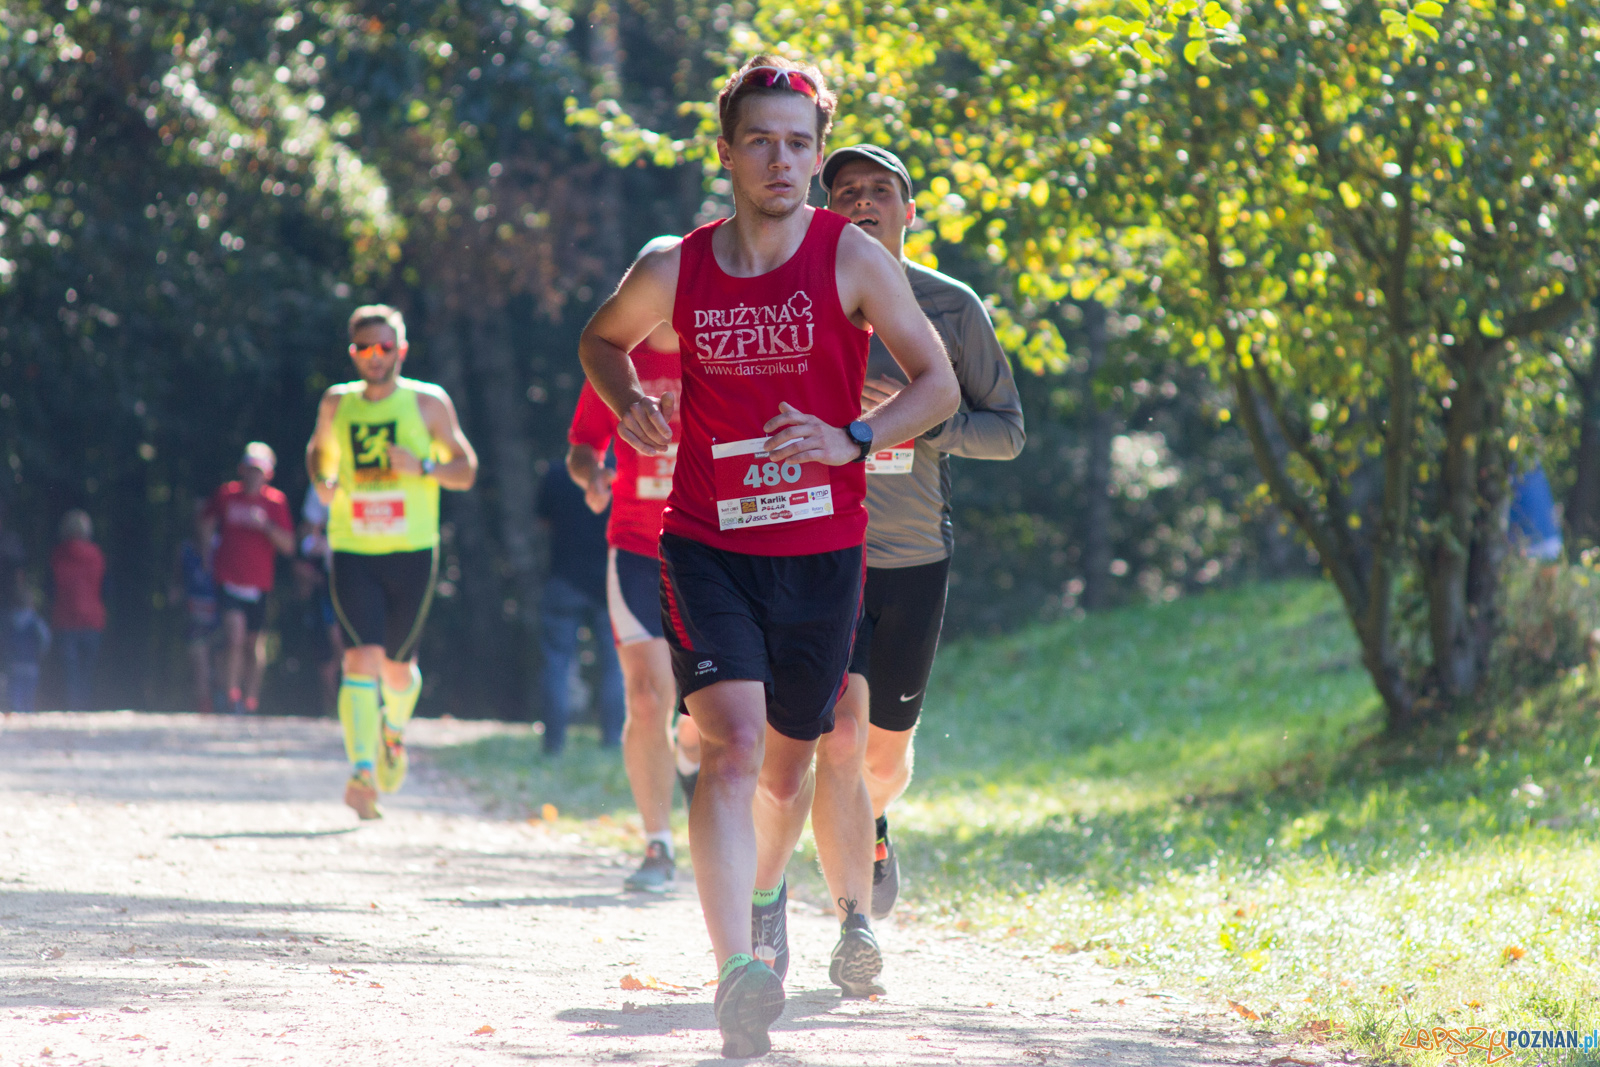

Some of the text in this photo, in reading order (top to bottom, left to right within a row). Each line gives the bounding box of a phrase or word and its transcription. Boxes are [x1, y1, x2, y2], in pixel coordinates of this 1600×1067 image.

[694, 303, 793, 328] DRUŻYNA
[695, 323, 815, 360] SZPIKU
[704, 359, 808, 376] www.darszpiku.pl
[743, 462, 802, 488] 480
[760, 496, 787, 505] Karlik
